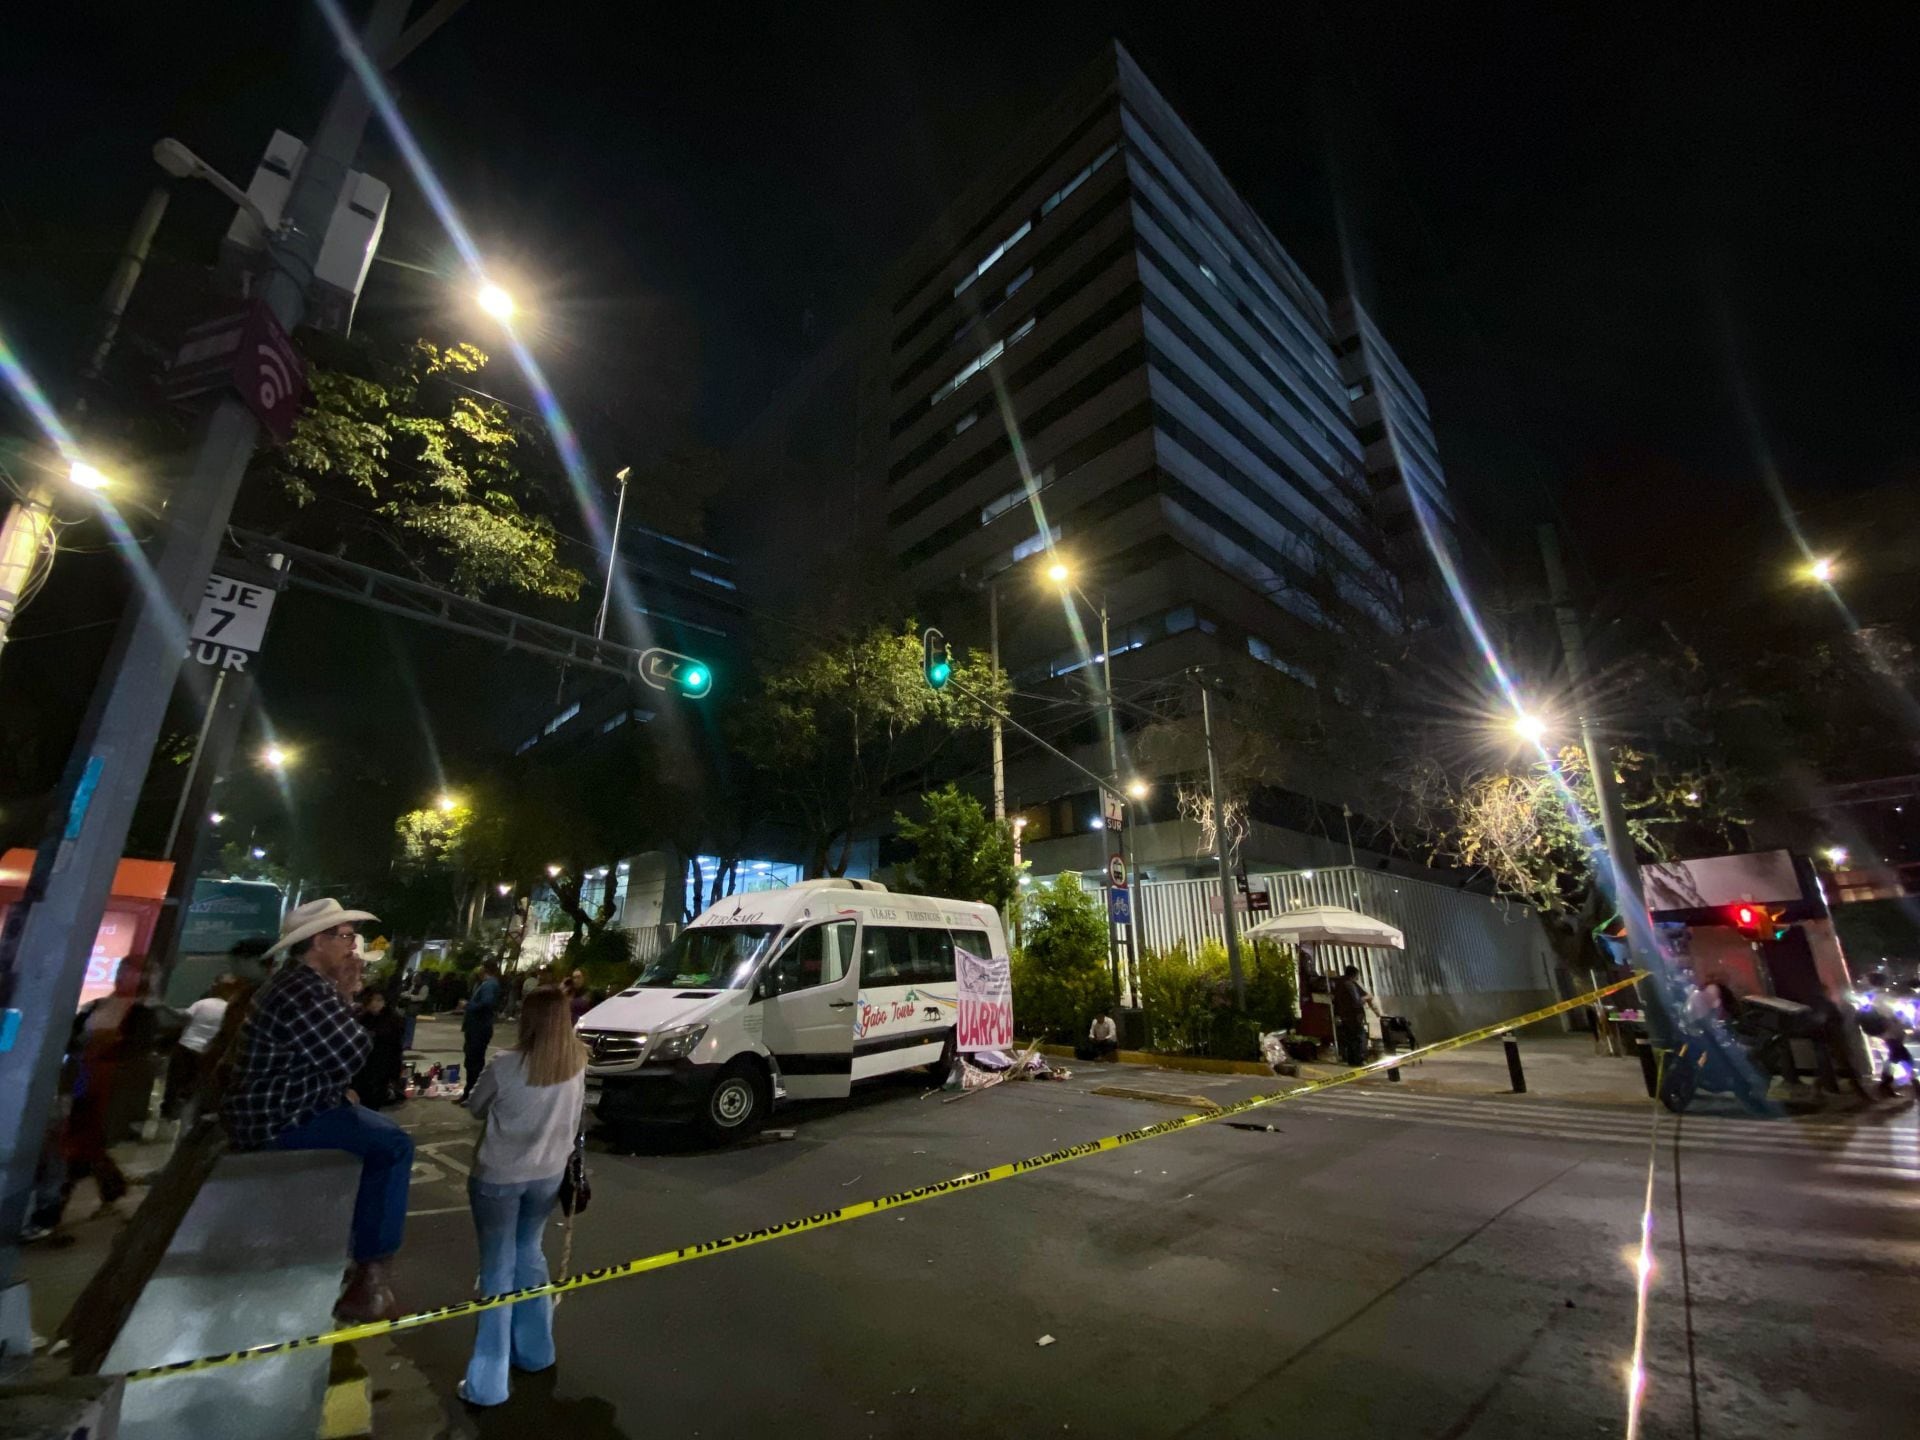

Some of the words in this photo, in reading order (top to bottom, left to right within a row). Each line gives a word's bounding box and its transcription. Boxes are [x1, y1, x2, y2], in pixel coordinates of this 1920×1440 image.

[206, 608, 235, 637] 7
[1107, 818, 1122, 832] SUR
[870, 908, 897, 921] VIAJES
[861, 1004, 887, 1038] Gabo
[892, 1001, 916, 1023] Tours
